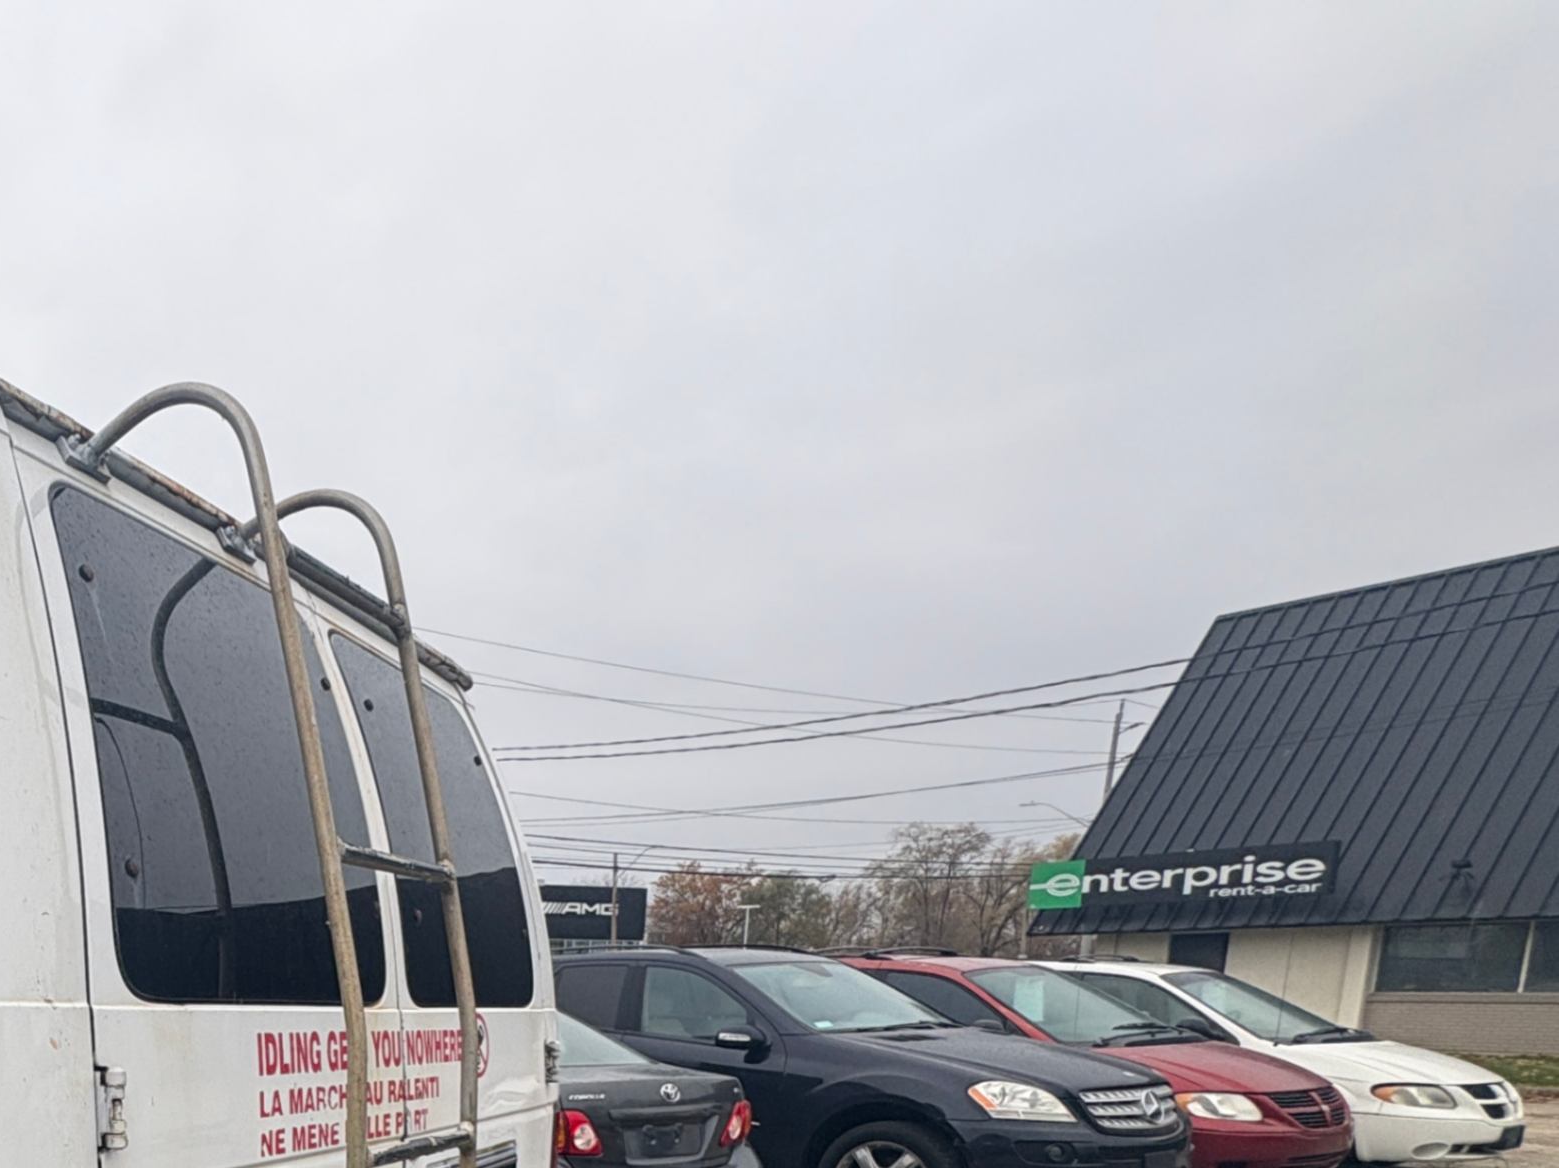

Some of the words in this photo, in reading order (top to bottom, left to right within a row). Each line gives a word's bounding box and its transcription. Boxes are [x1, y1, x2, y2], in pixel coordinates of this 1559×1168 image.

[1045, 854, 1327, 897] enterprise
[1208, 881, 1323, 898] rent-a-car
[256, 1031, 322, 1077] IDLING
[327, 1030, 349, 1072] GE
[371, 1030, 402, 1068] YOU
[406, 1029, 463, 1067] NOWHERE
[259, 1090, 283, 1118] LA
[289, 1084, 348, 1115] MARCH
[365, 1080, 383, 1106] AU
[388, 1076, 440, 1104] RALENTI
[260, 1130, 287, 1157] NE
[292, 1122, 340, 1152] MENE
[367, 1112, 391, 1140] LLE
